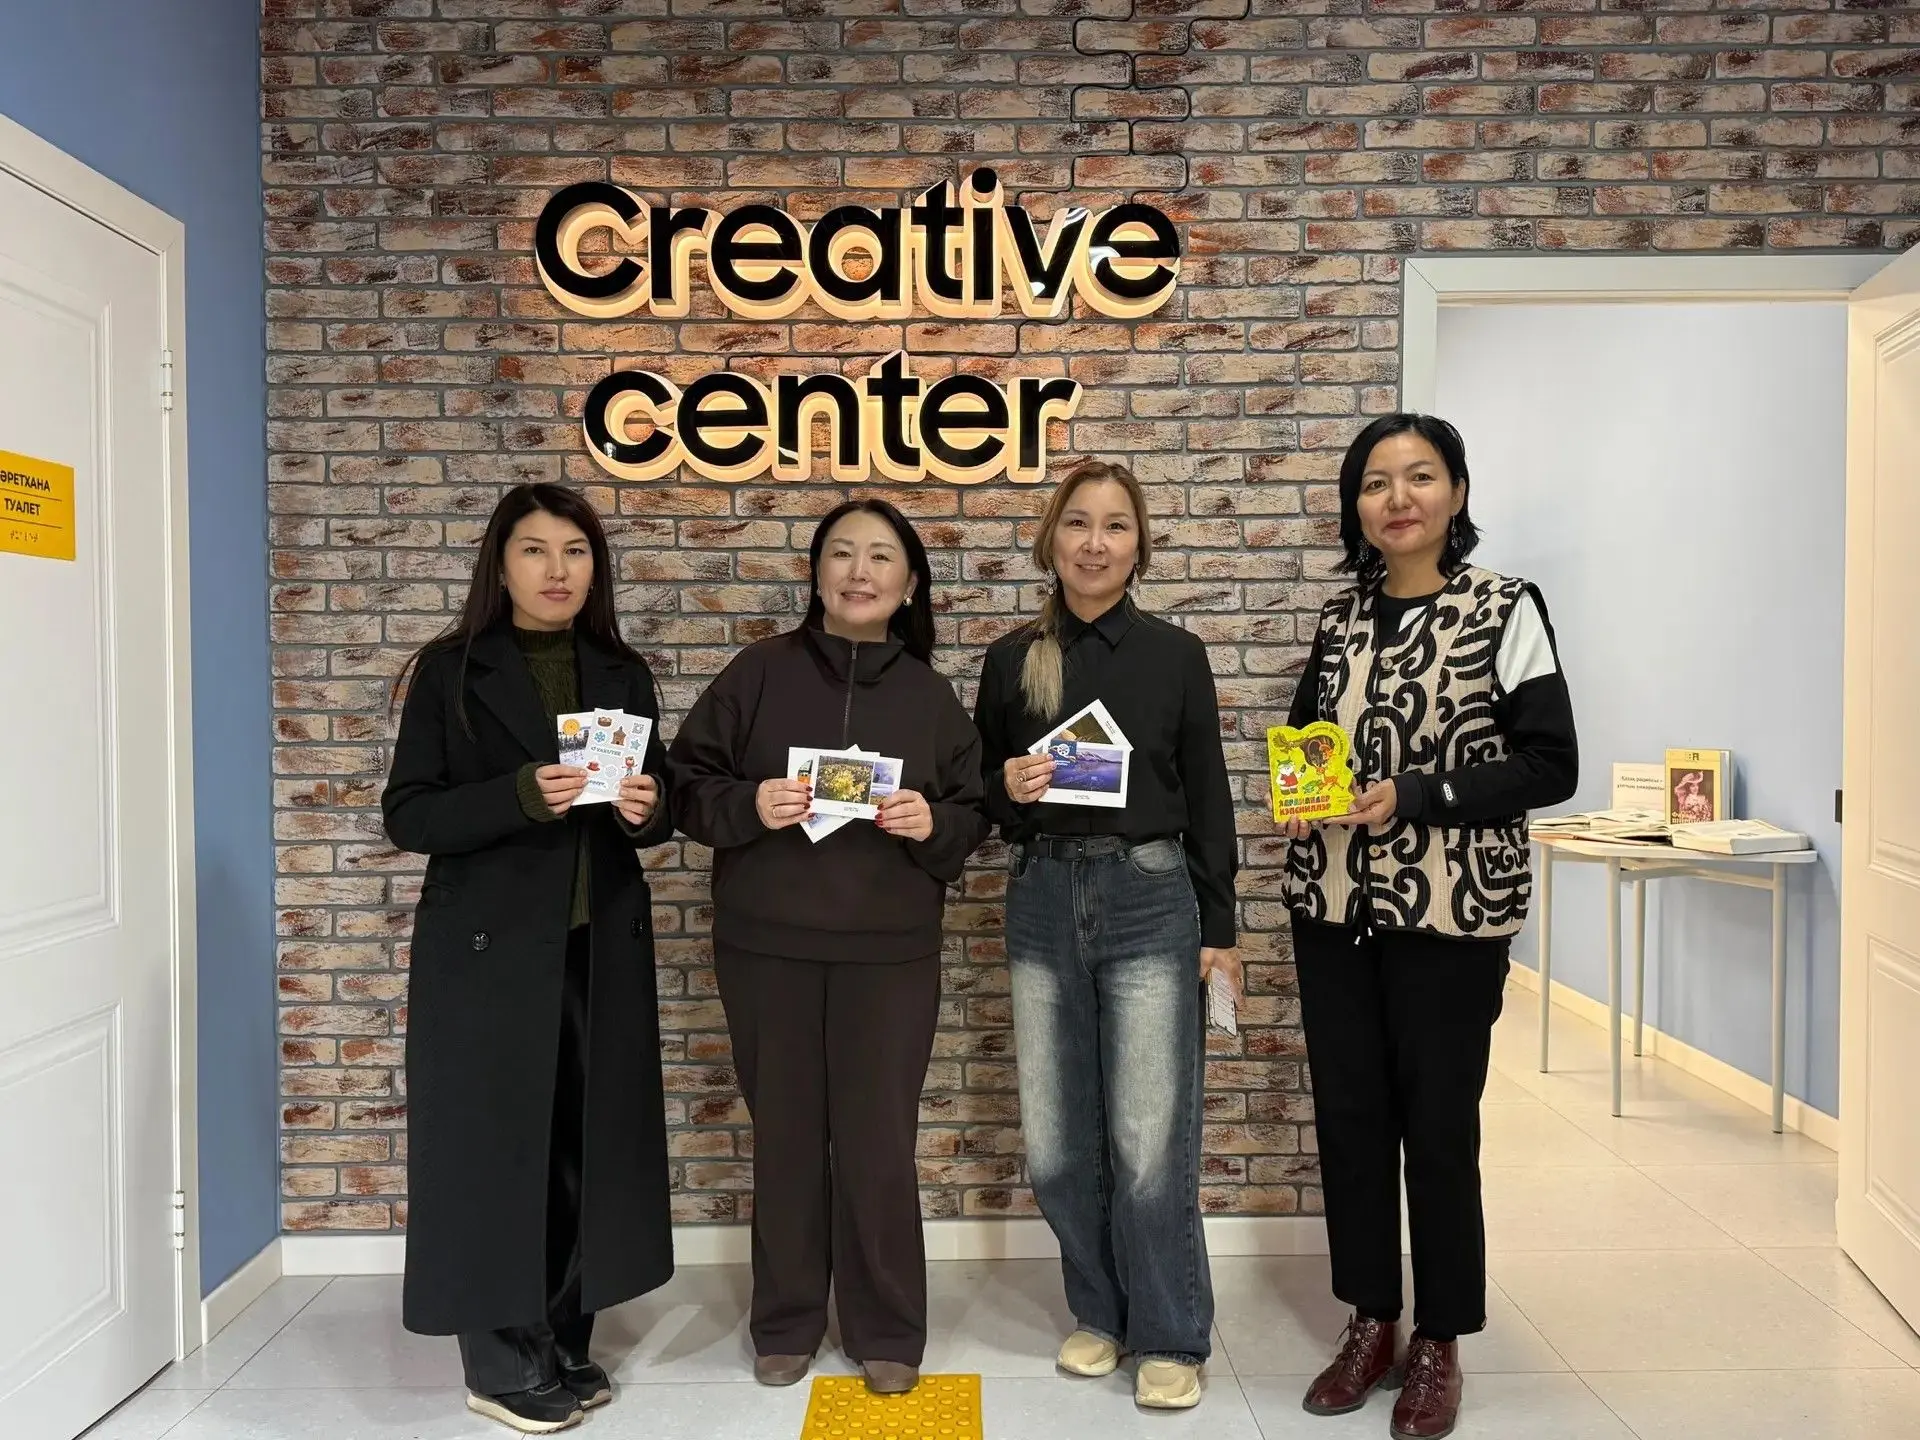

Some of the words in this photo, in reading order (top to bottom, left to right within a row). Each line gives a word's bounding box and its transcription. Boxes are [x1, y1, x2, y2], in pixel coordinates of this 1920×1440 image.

[535, 166, 1181, 304] Creative
[583, 355, 1077, 468] center
[0, 470, 51, 492] ӘРЕТХАНА
[4, 497, 41, 516] ТУАЛЕТ
